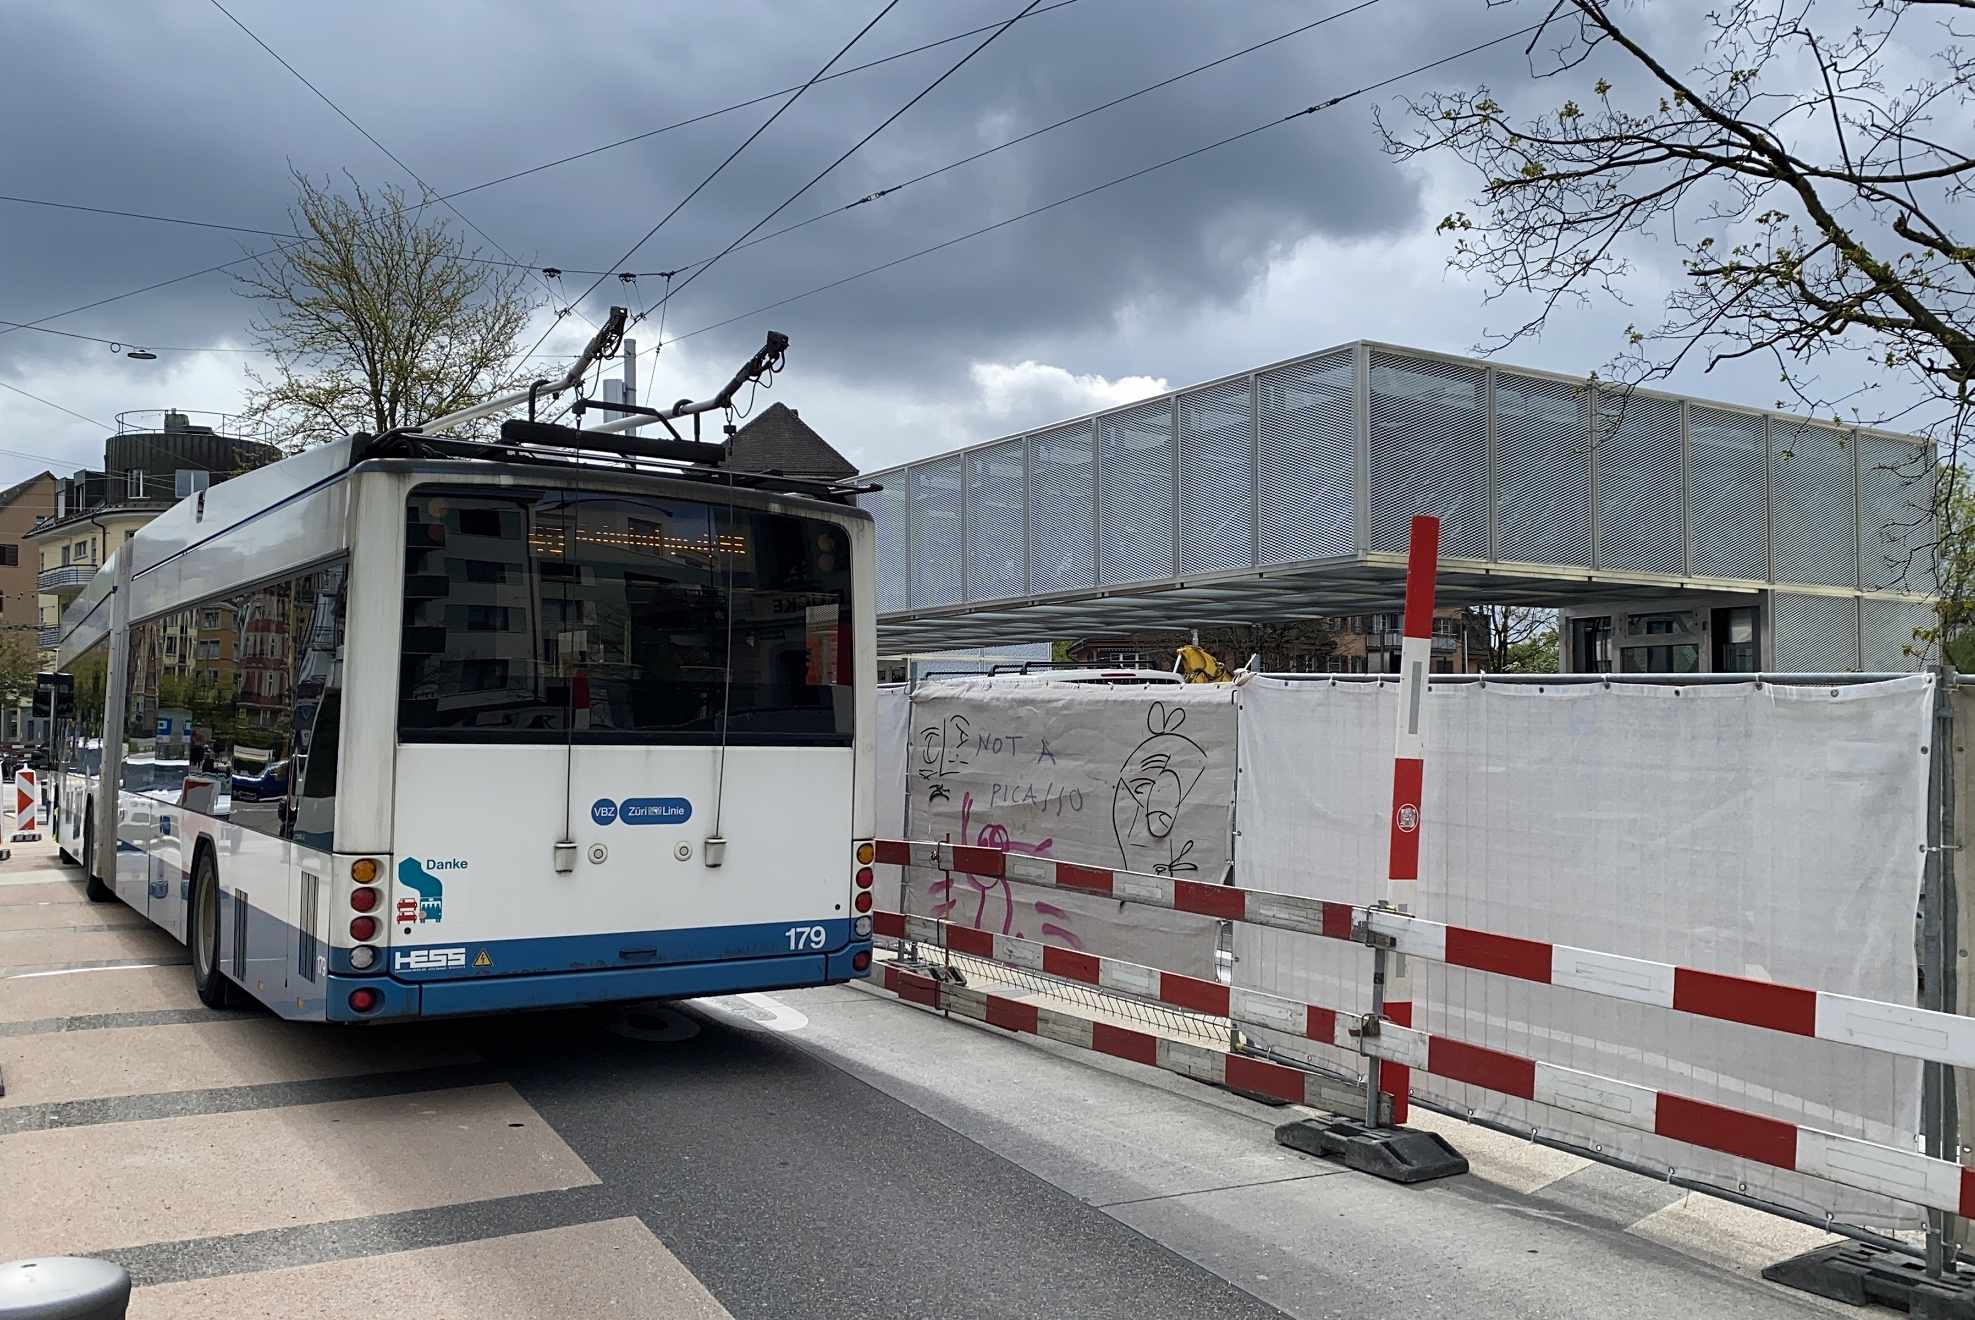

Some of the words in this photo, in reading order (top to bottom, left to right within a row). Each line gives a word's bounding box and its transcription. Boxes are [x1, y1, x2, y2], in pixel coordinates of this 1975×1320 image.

[976, 733, 1024, 757] NOT
[1037, 737, 1056, 765] A
[594, 807, 616, 817] VBZ
[628, 806, 647, 816] Züri
[663, 806, 685, 816] Linie
[426, 858, 468, 870] Danke
[785, 925, 826, 950] 179
[395, 948, 466, 970] HESS
